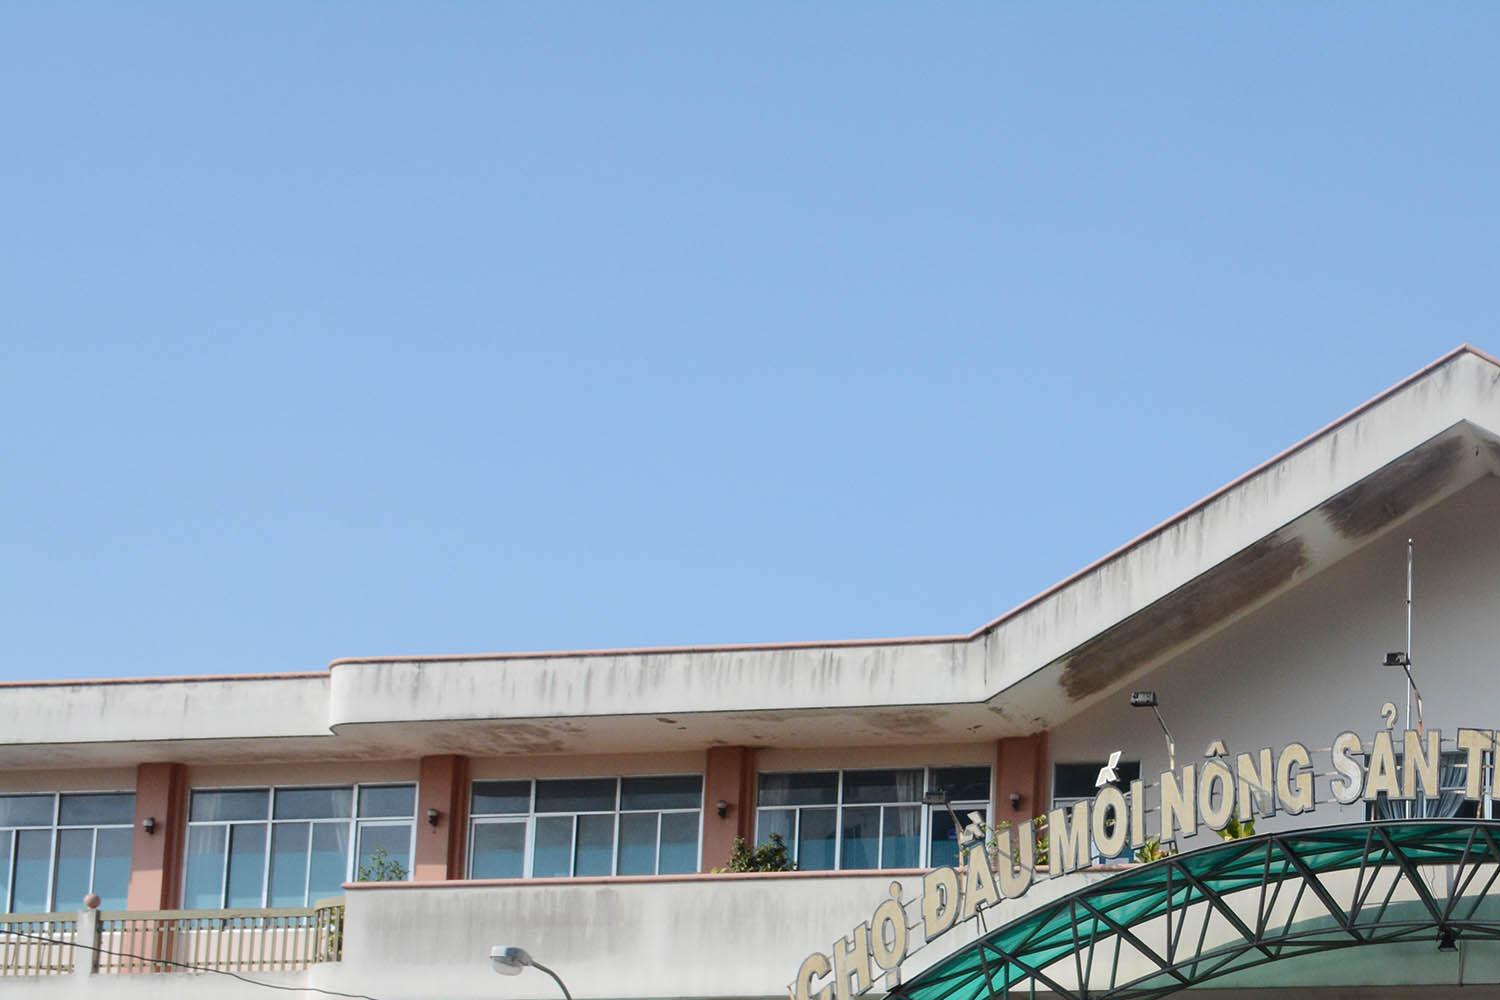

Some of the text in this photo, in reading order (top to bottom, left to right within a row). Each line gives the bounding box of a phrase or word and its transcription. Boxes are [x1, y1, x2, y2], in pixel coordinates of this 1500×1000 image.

[921, 810, 1034, 943] ĐẦU
[1049, 750, 1145, 879] MỐI
[1159, 740, 1318, 843] NÔNG
[1330, 702, 1441, 804] SẢN
